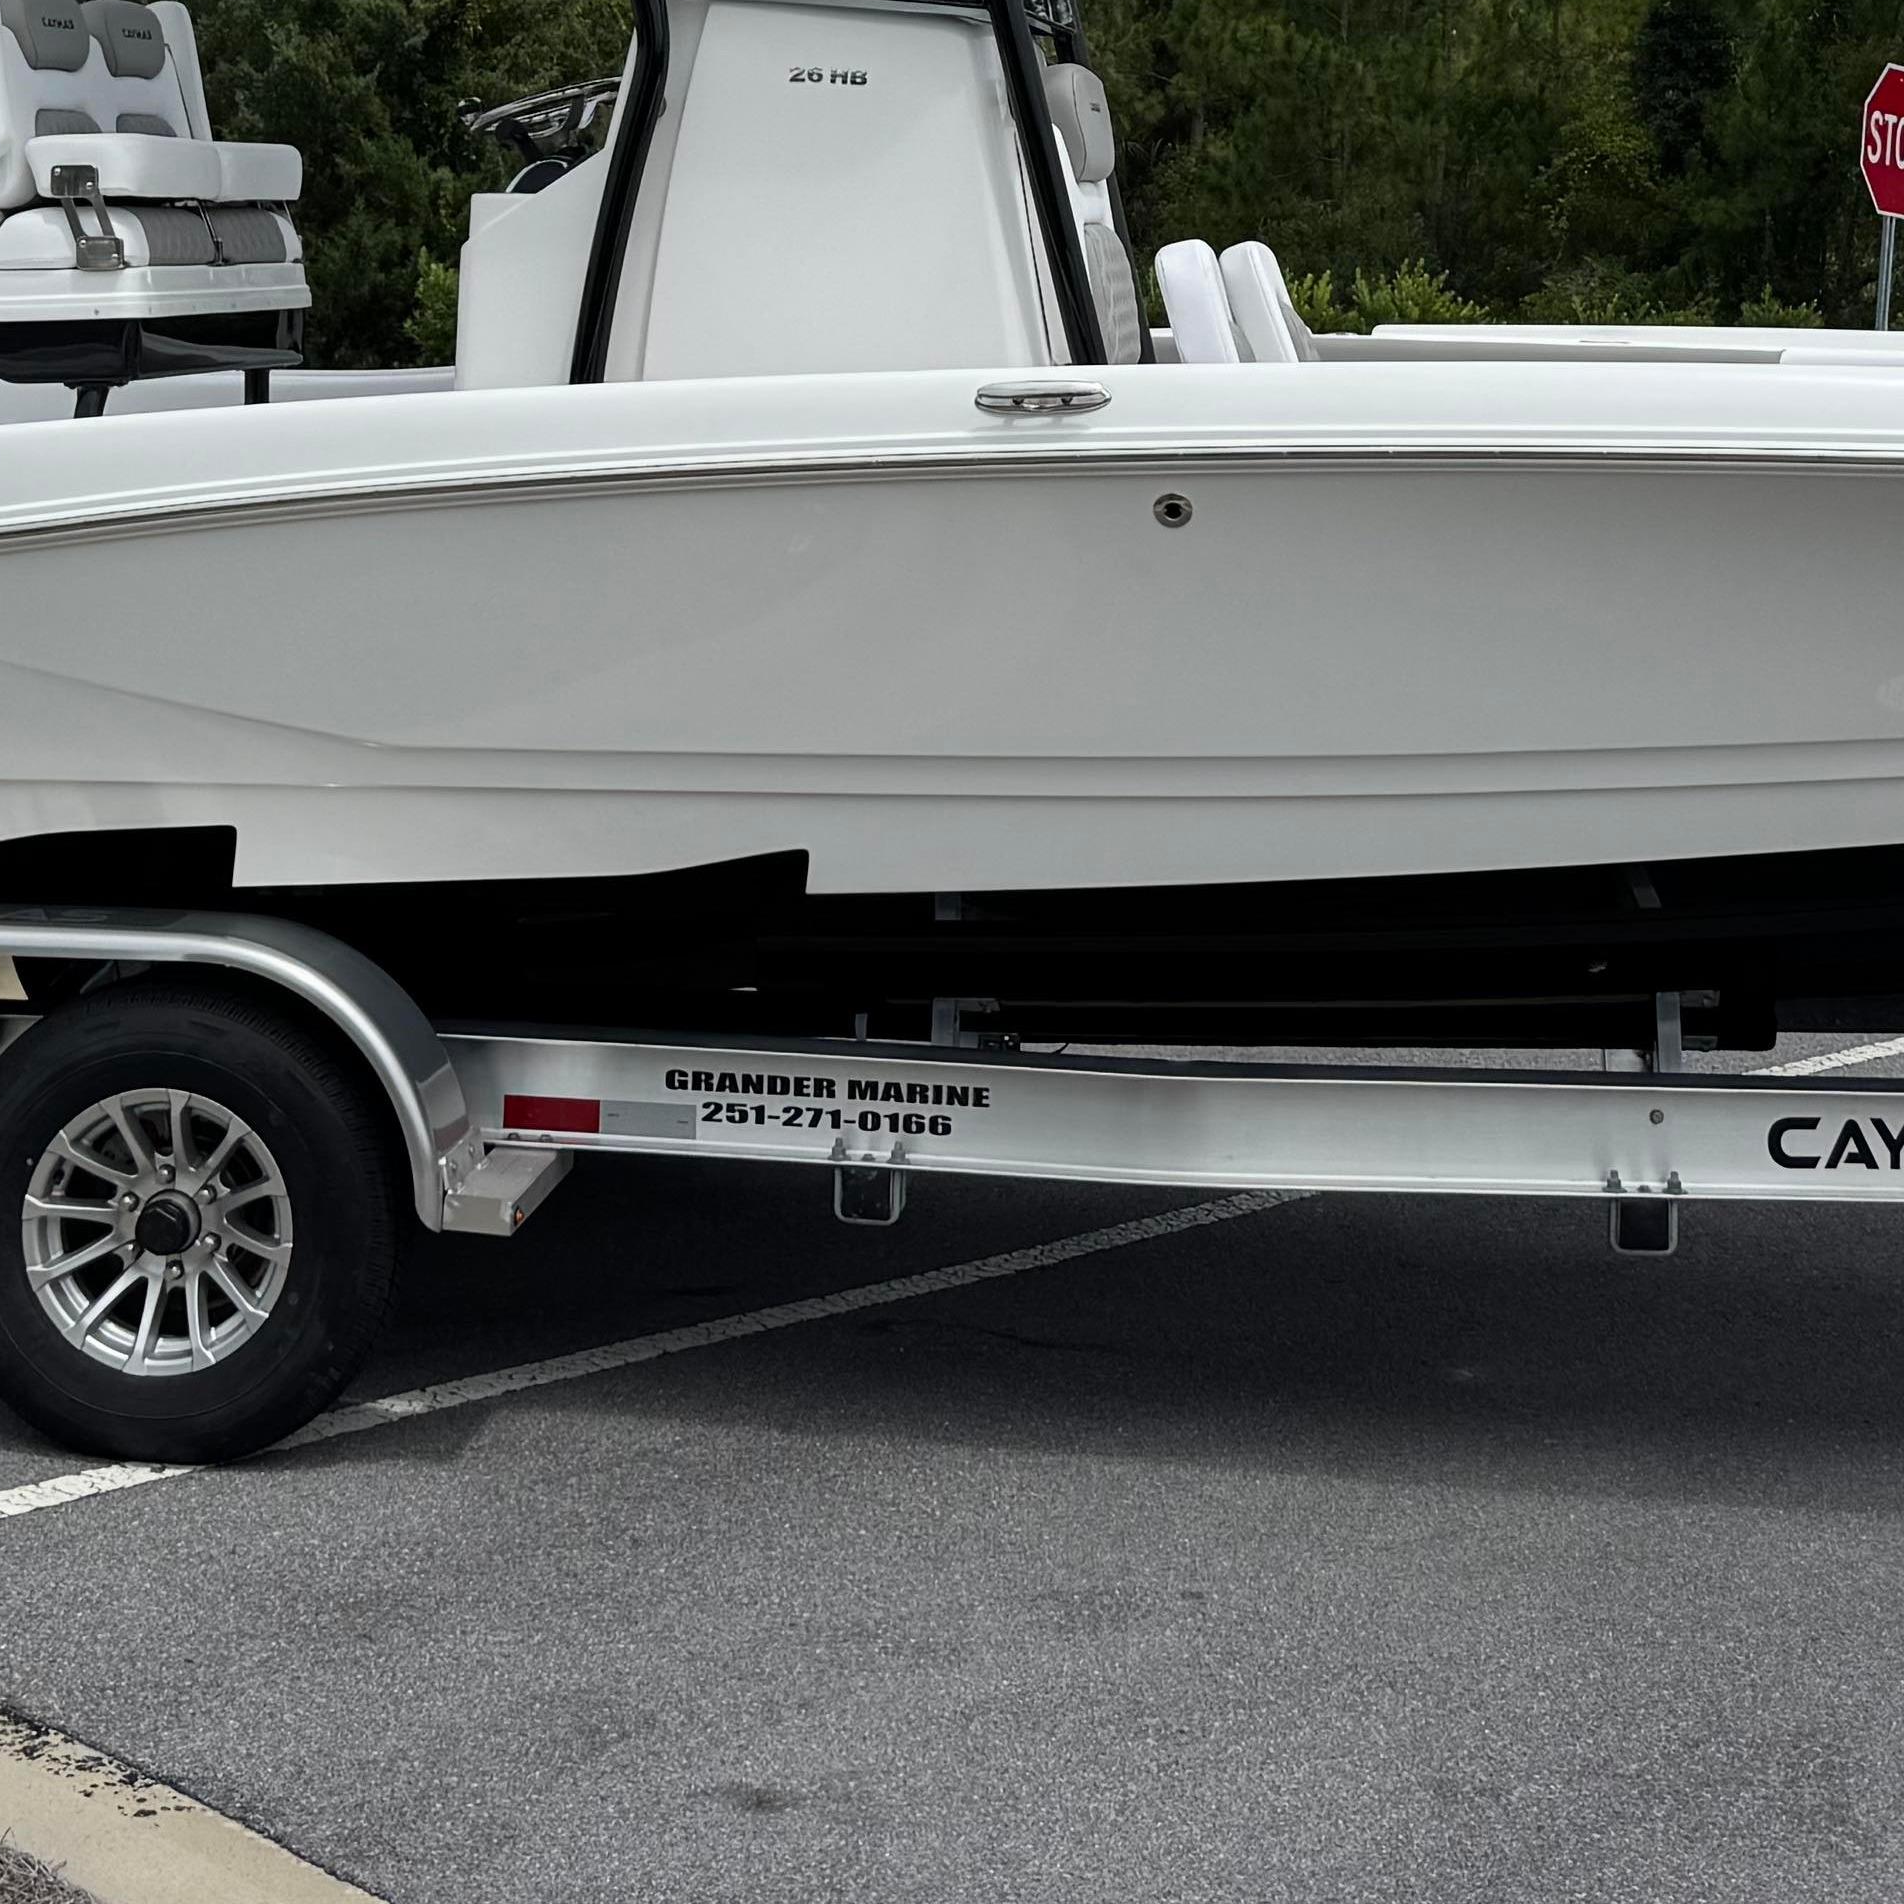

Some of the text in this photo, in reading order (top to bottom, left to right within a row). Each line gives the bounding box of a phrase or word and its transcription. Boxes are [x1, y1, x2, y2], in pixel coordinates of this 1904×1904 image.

[789, 66, 867, 85] 26 HB
[665, 1069, 991, 1108] GRANDER MARINE
[701, 1101, 953, 1136] 251-271-0166
